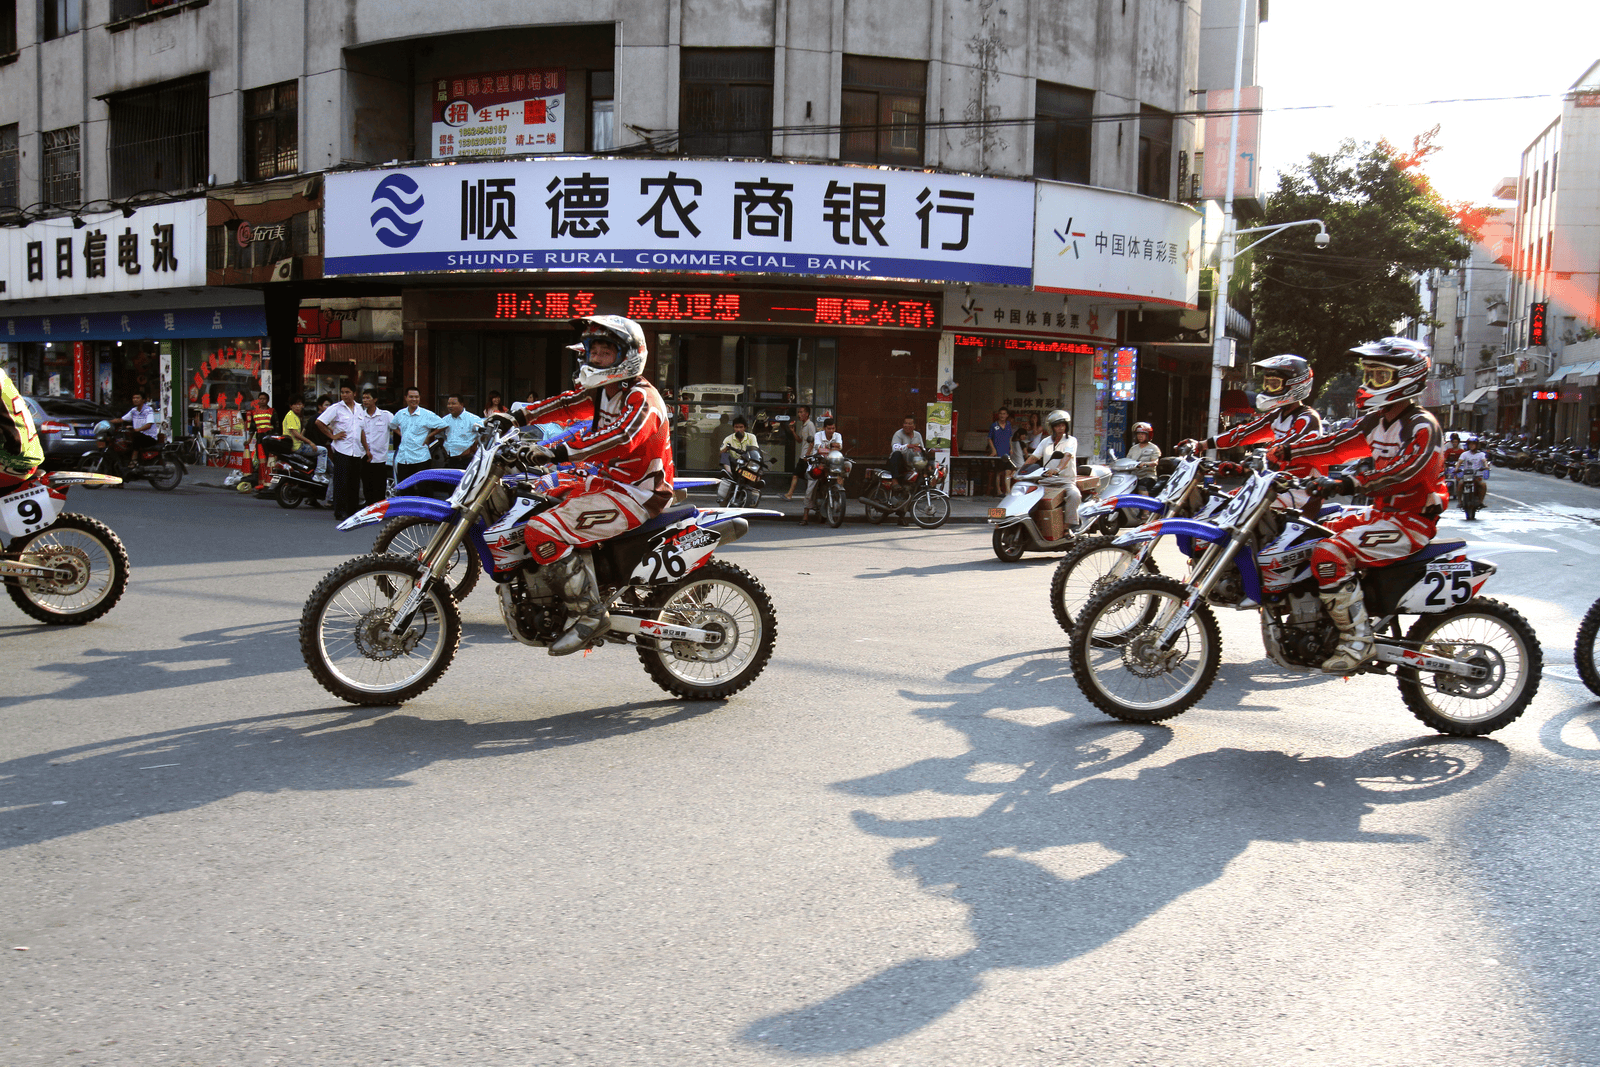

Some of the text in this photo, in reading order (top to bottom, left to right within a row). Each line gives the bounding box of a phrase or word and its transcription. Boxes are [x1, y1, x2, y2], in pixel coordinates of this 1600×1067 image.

[437, 80, 448, 101] 首届
[452, 72, 559, 98] 国际发型师培训
[439, 134, 454, 145] 招生
[439, 145, 454, 156] 预约
[515, 133, 556, 146] 请上二楼
[461, 170, 975, 251] 顺德农商银行
[27, 223, 178, 282] 日日信电讯
[1095, 231, 1178, 265] 中国体育彩票
[447, 252, 871, 271] SHUNDE RURAL COMMERCIAL BANK
[994, 308, 1079, 328] 中国体育彩票
[17, 499, 43, 525] 9
[642, 545, 686, 585] 26
[1424, 571, 1472, 606] 25
